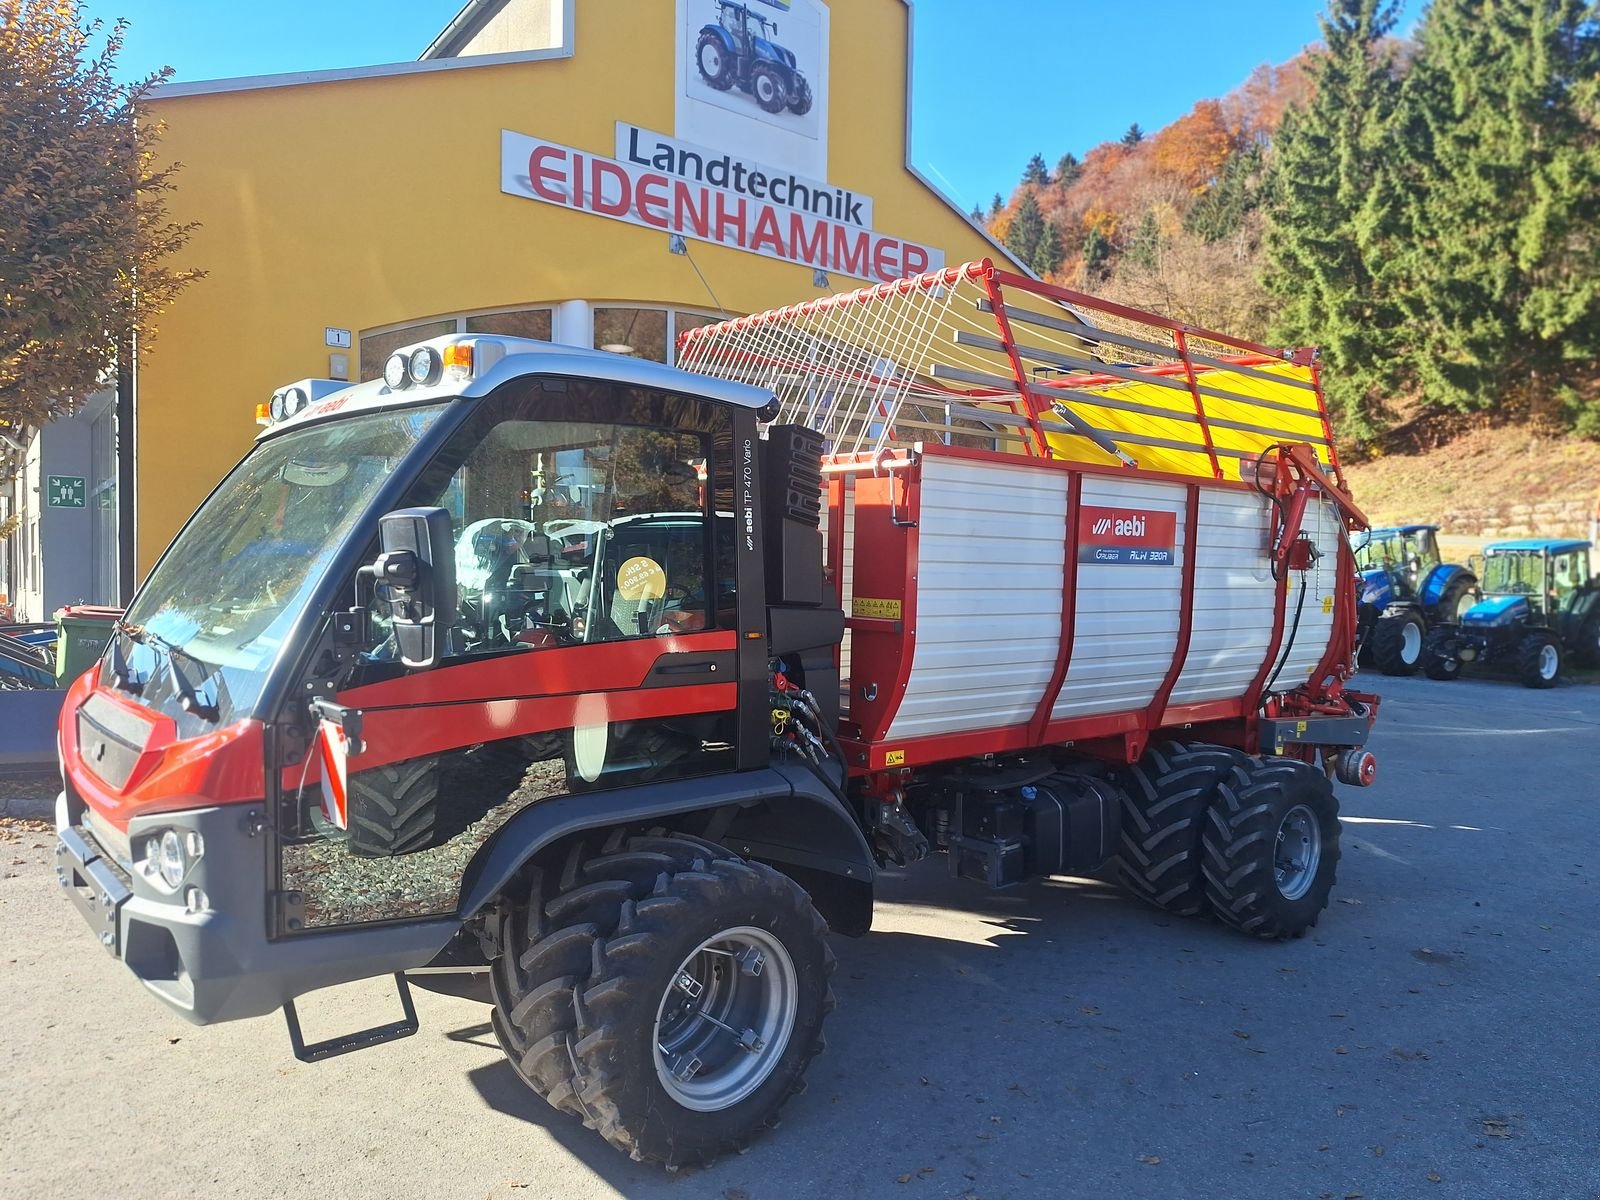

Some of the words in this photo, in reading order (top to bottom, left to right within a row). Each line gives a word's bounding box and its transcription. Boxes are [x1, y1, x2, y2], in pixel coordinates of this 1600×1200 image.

[629, 126, 864, 225] Landtechnik
[528, 145, 928, 283] EIDENHAMMER
[743, 439, 751, 465] Vario
[743, 467, 752, 487] 470
[744, 490, 752, 504] TP
[744, 507, 753, 533] aebi
[1115, 515, 1145, 537] aebi
